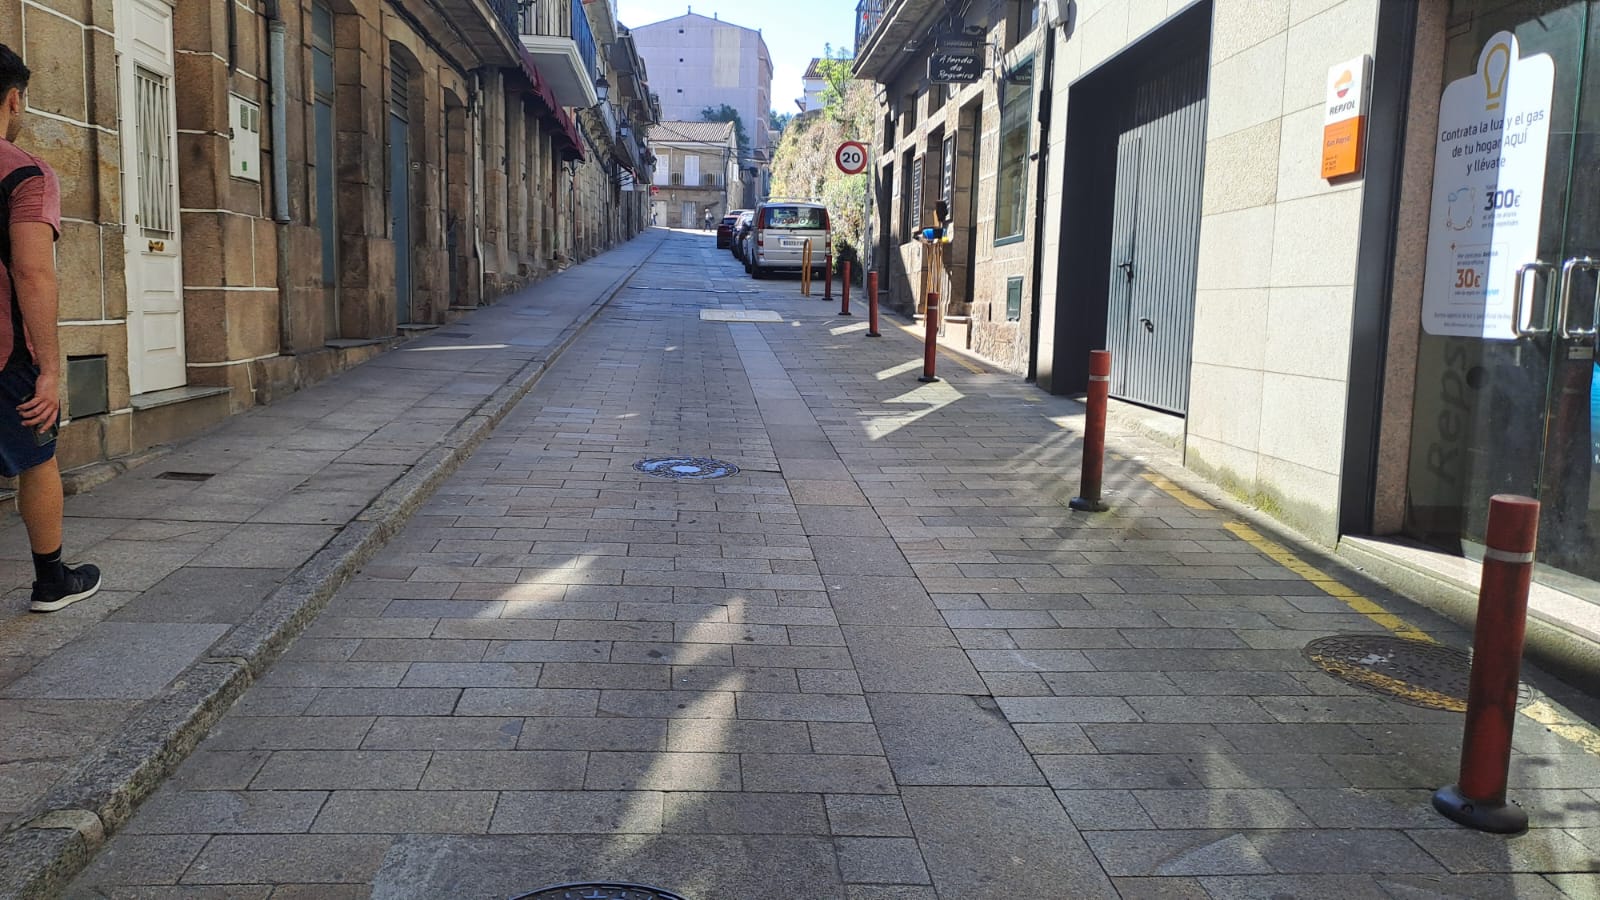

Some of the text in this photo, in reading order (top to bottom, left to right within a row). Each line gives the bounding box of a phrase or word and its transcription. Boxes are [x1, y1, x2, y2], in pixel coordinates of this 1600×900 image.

[1330, 101, 1355, 115] REPSOL
[1441, 110, 1544, 142] Contrata la luz y el gas
[1452, 127, 1529, 158] de tu hogar AQUÍ
[842, 152, 861, 164] 20
[1466, 157, 1506, 176] y llévate
[1484, 189, 1521, 211] 300€
